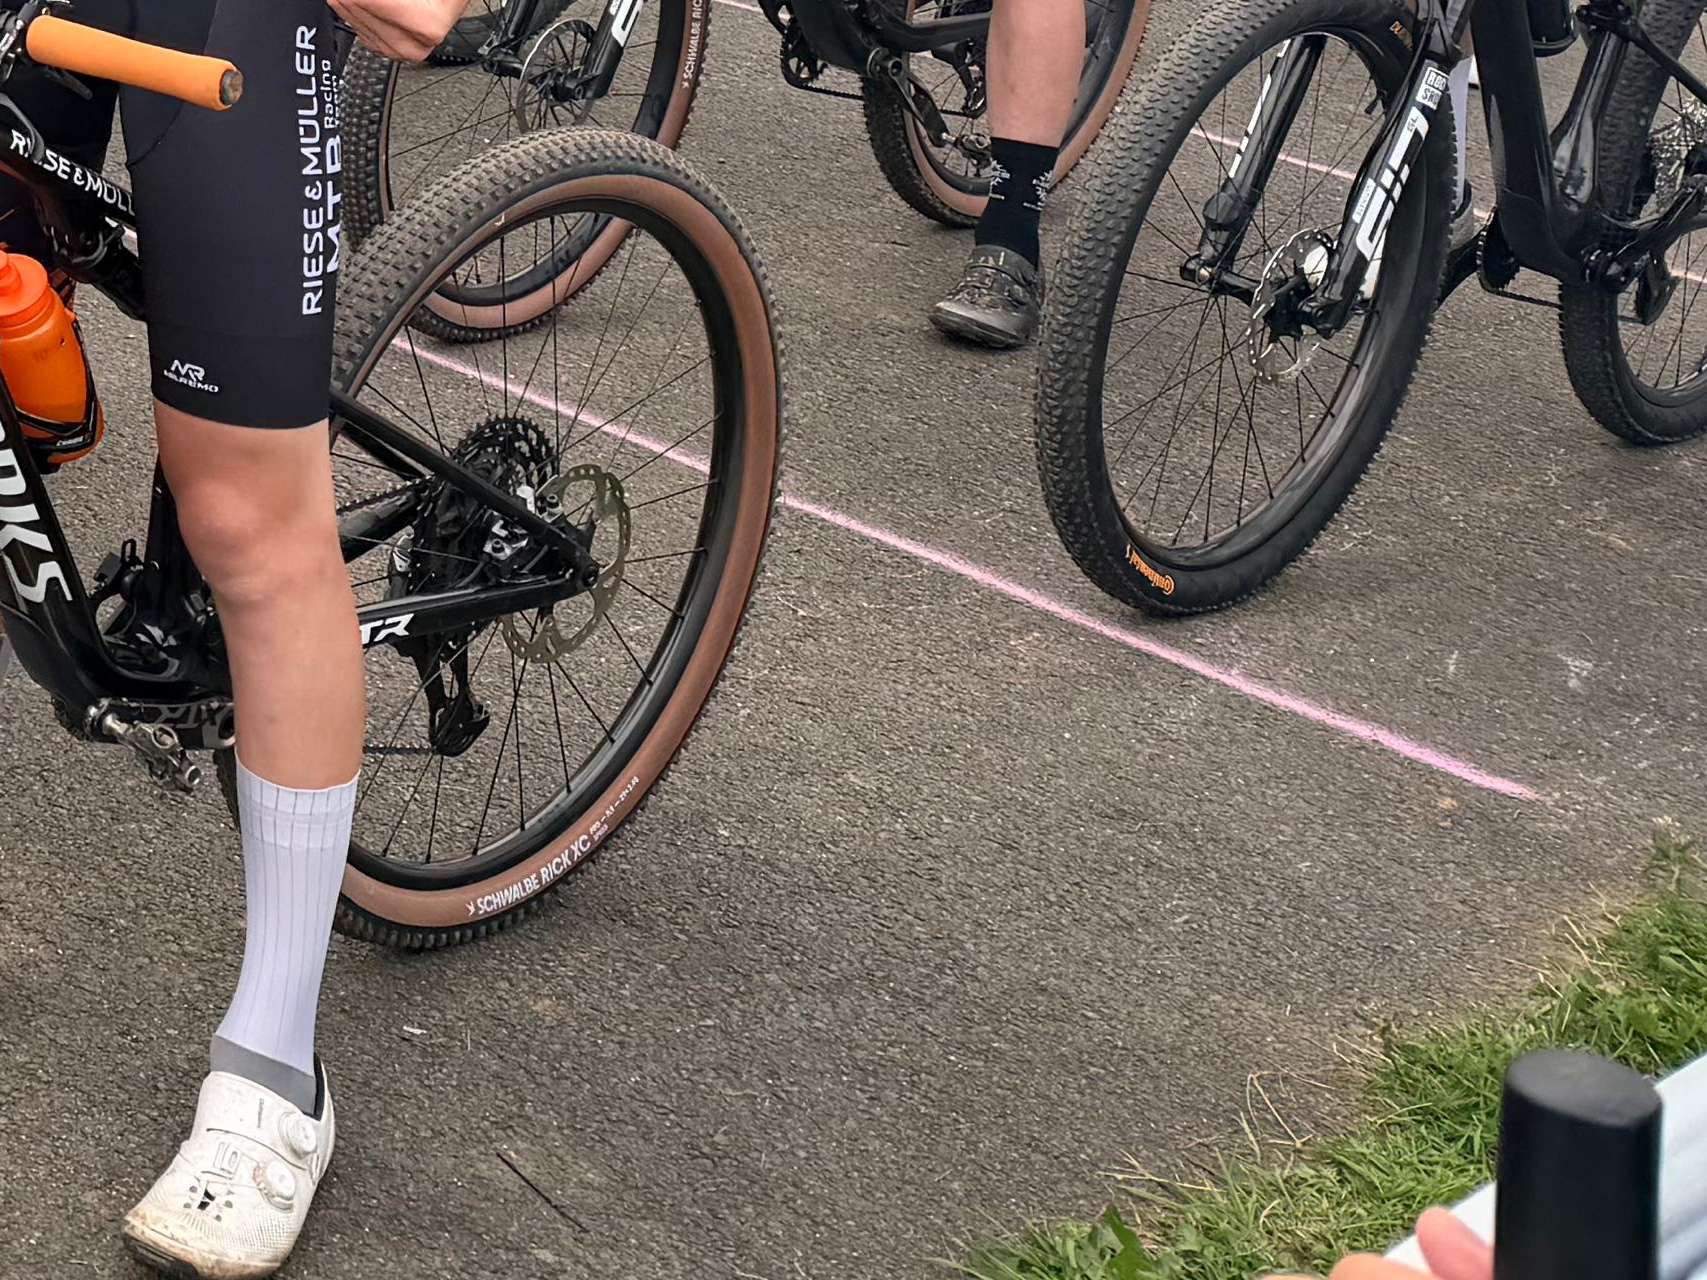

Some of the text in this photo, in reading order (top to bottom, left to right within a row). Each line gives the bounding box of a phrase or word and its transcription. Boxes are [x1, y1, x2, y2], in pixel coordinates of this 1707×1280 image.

[683, 21, 701, 90] SCHWALBE
[295, 25, 324, 315] RIESE & MÜLLER
[321, 59, 343, 272] MTB Racing
[360, 613, 414, 643] TR
[477, 833, 590, 915] SCHWALBE RICK XC
